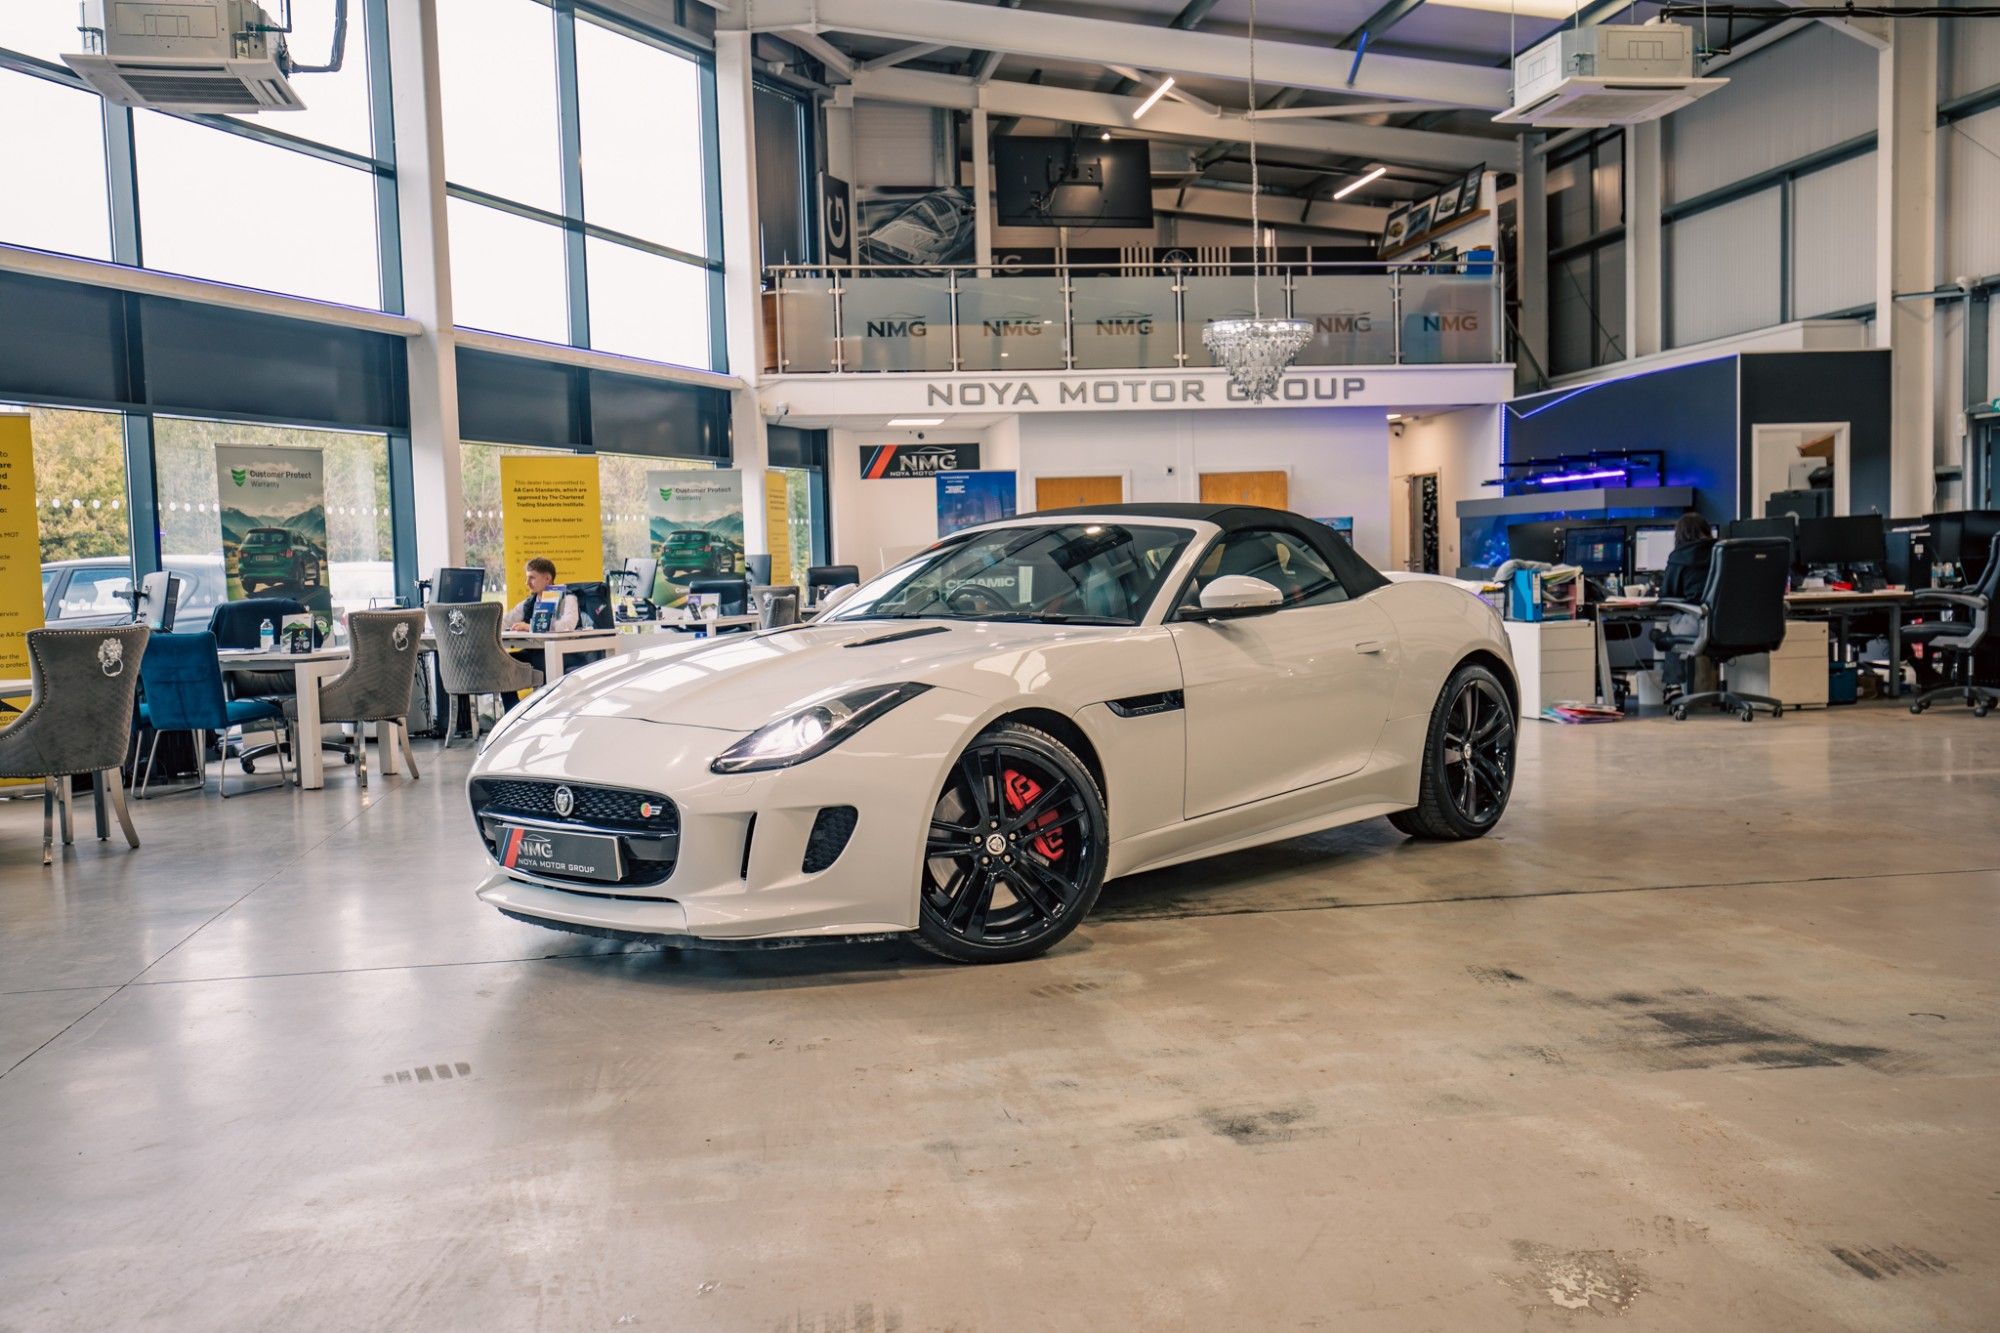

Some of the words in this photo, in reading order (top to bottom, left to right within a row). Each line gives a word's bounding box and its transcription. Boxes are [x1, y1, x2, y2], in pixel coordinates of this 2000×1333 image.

[866, 320, 928, 338] NMG
[983, 320, 1043, 337] NMG
[1096, 319, 1154, 336] NMG
[1316, 316, 1373, 333] NMG
[1423, 315, 1478, 332] NMG
[927, 382, 1039, 406] NOYA
[1059, 379, 1206, 404] MOTOR
[1226, 377, 1366, 402] GROUP
[899, 454, 957, 471] NMG
[249, 470, 284, 479] Customer
[285, 471, 312, 480] Protect
[250, 480, 280, 489] Warranty
[518, 840, 553, 859] NMG
[518, 858, 538, 867] NOYA
[539, 860, 566, 870] MOTOR
[568, 863, 595, 874] GROUP
